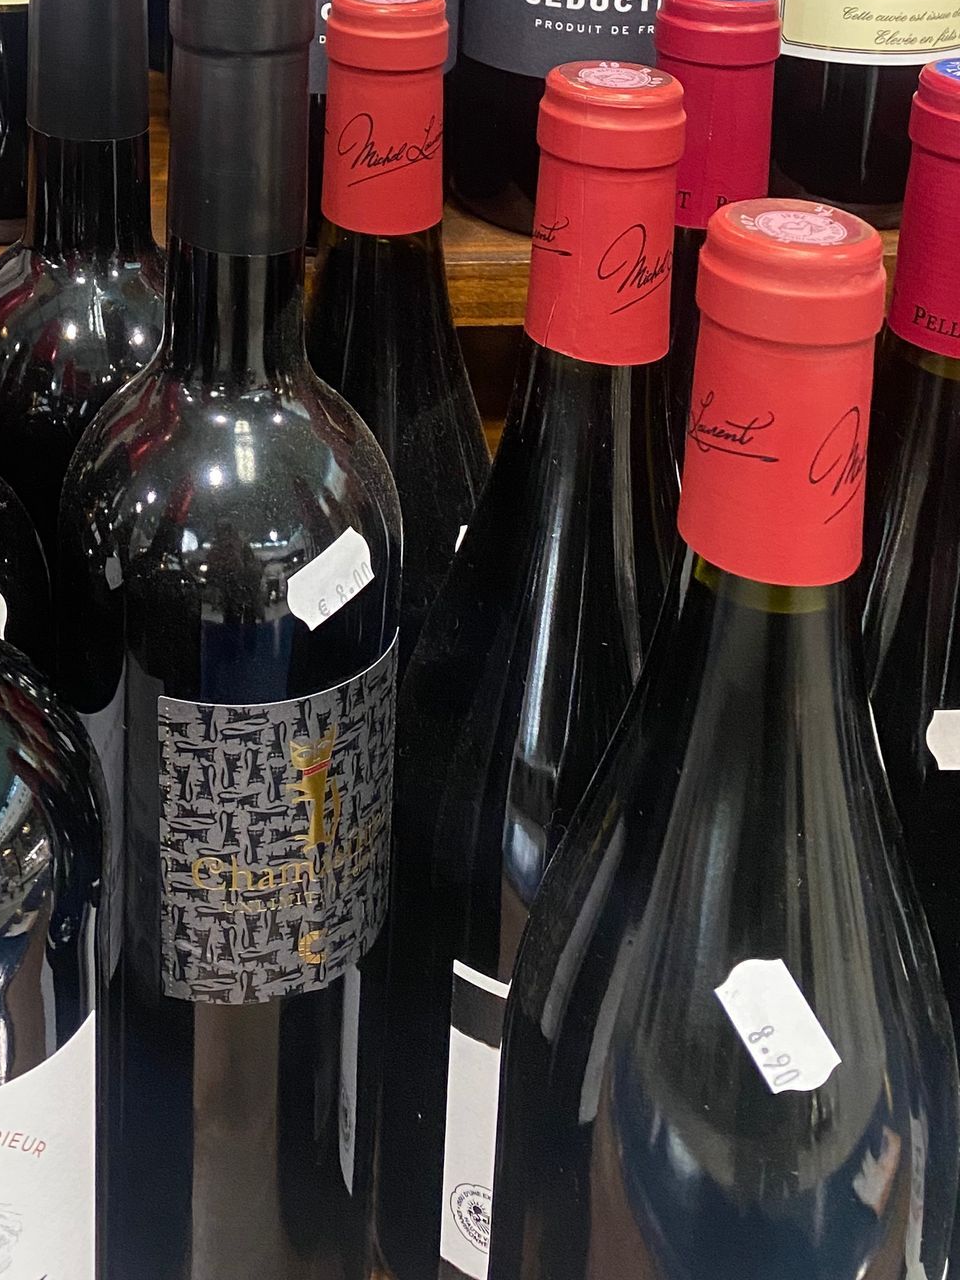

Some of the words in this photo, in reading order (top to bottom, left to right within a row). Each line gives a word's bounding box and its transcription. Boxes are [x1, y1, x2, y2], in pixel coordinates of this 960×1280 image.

[534, 18, 602, 35] PRODUIT
[611, 25, 629, 35] DE
[919, 35, 935, 45] en
[748, 1025, 800, 1087] 8.90
